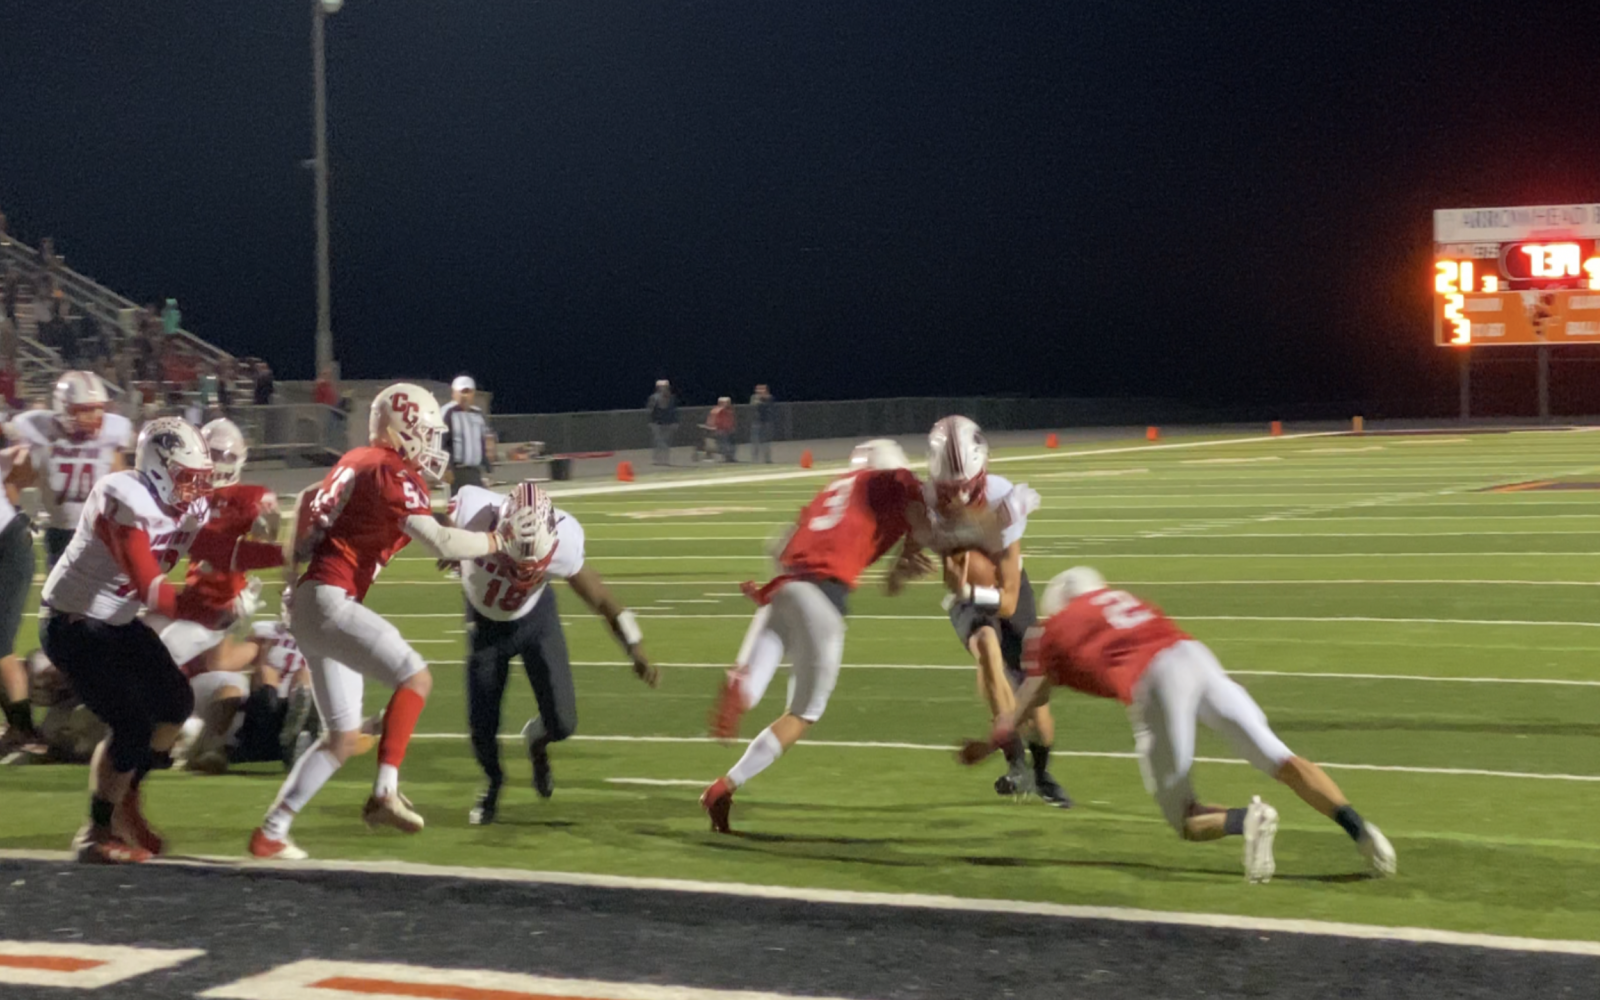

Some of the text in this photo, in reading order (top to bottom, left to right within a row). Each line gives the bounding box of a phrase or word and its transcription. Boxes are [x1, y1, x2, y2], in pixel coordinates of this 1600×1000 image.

[1436, 261, 1473, 292] 21
[1445, 293, 1464, 318] 2
[1451, 319, 1471, 344] 3
[390, 391, 420, 426] CC
[807, 474, 857, 532] 3
[1089, 589, 1157, 629] 2
